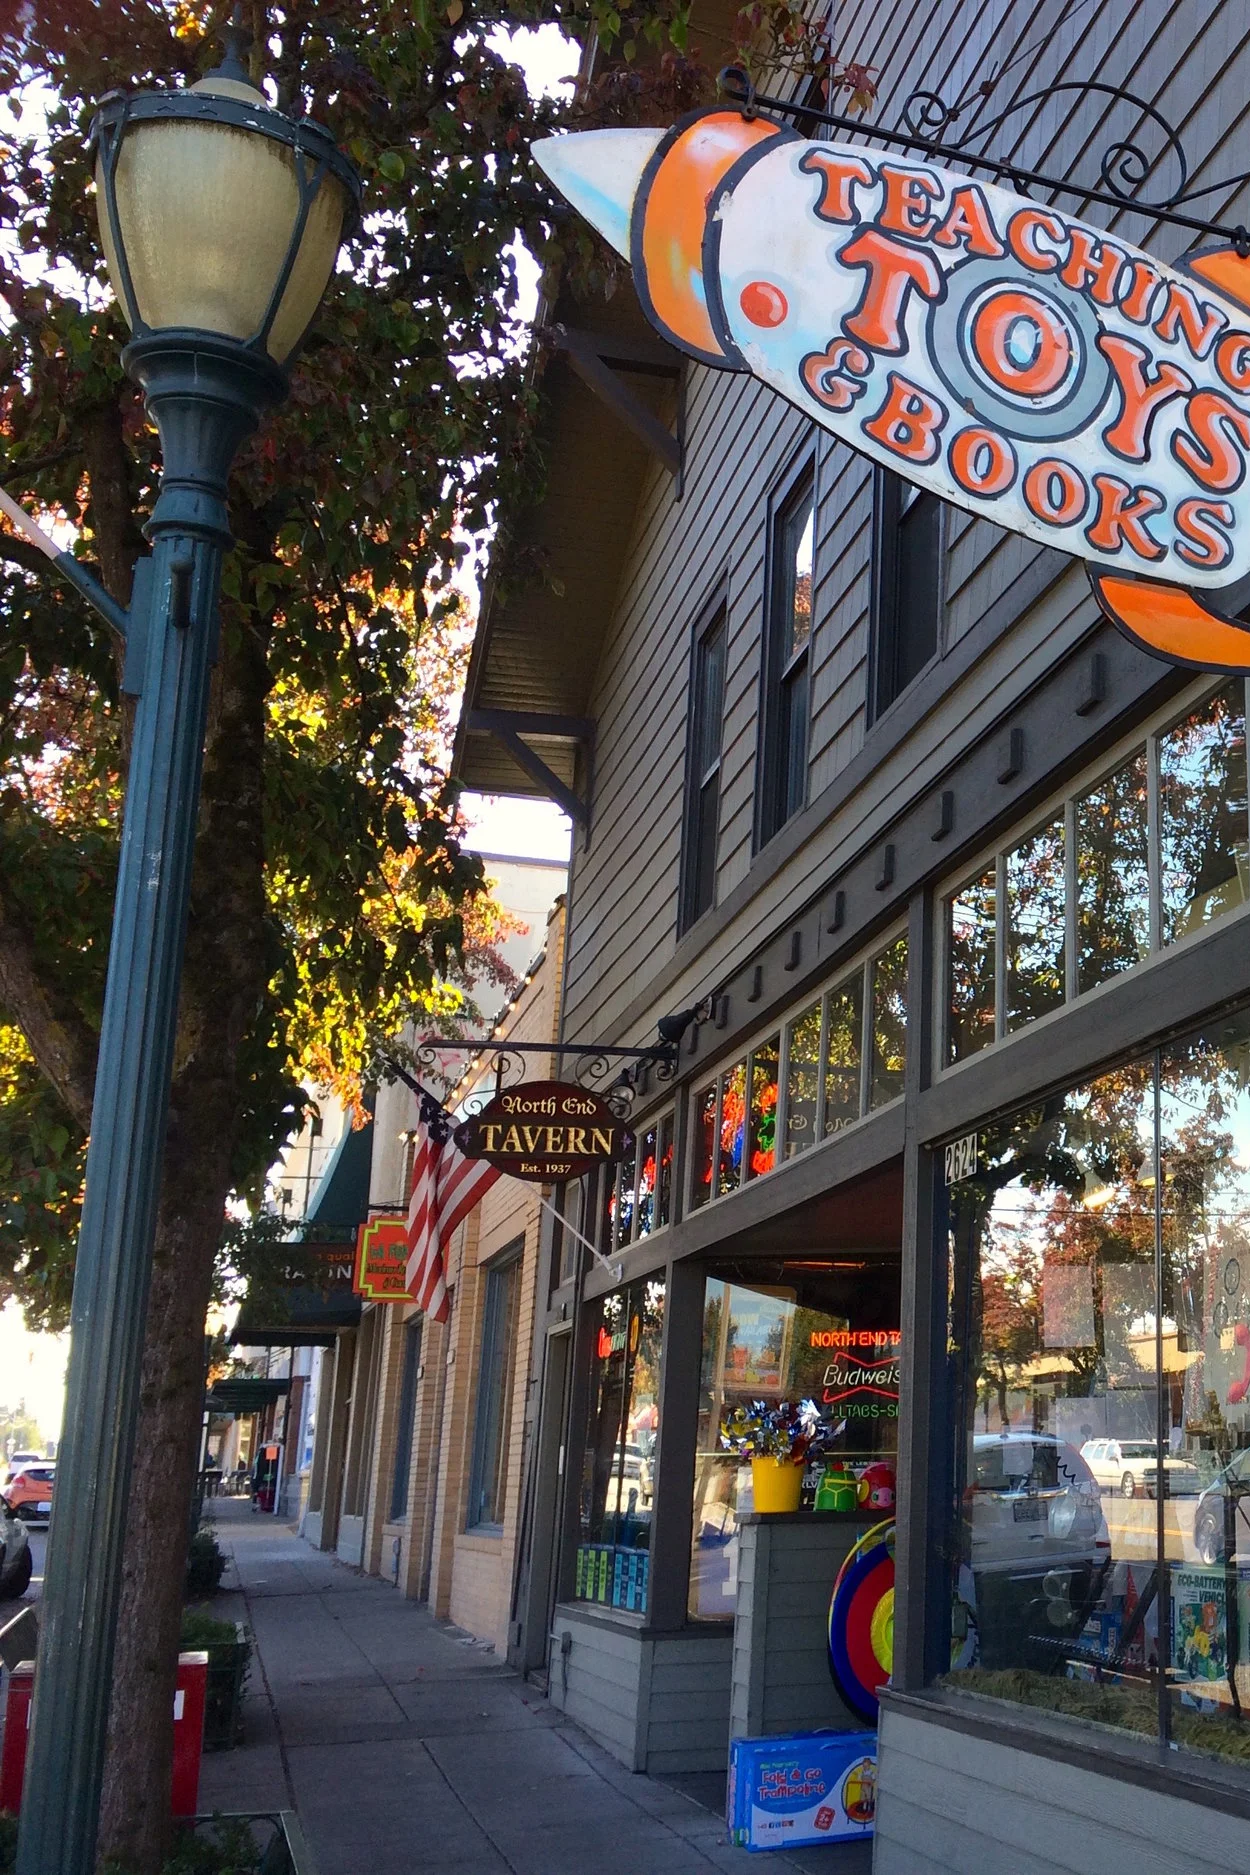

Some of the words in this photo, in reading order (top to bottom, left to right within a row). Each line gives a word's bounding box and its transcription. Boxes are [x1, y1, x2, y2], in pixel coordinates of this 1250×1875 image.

[802, 345, 872, 412] &
[865, 369, 1237, 569] BOOKS
[502, 1096, 557, 1116] North
[562, 1097, 597, 1115] End
[479, 1124, 615, 1155] TAVERN
[520, 1163, 541, 1173] Est.
[546, 1164, 572, 1174] 1937
[946, 1135, 976, 1184] 2624
[810, 1331, 853, 1347] NORTH
[855, 1331, 887, 1346] END
